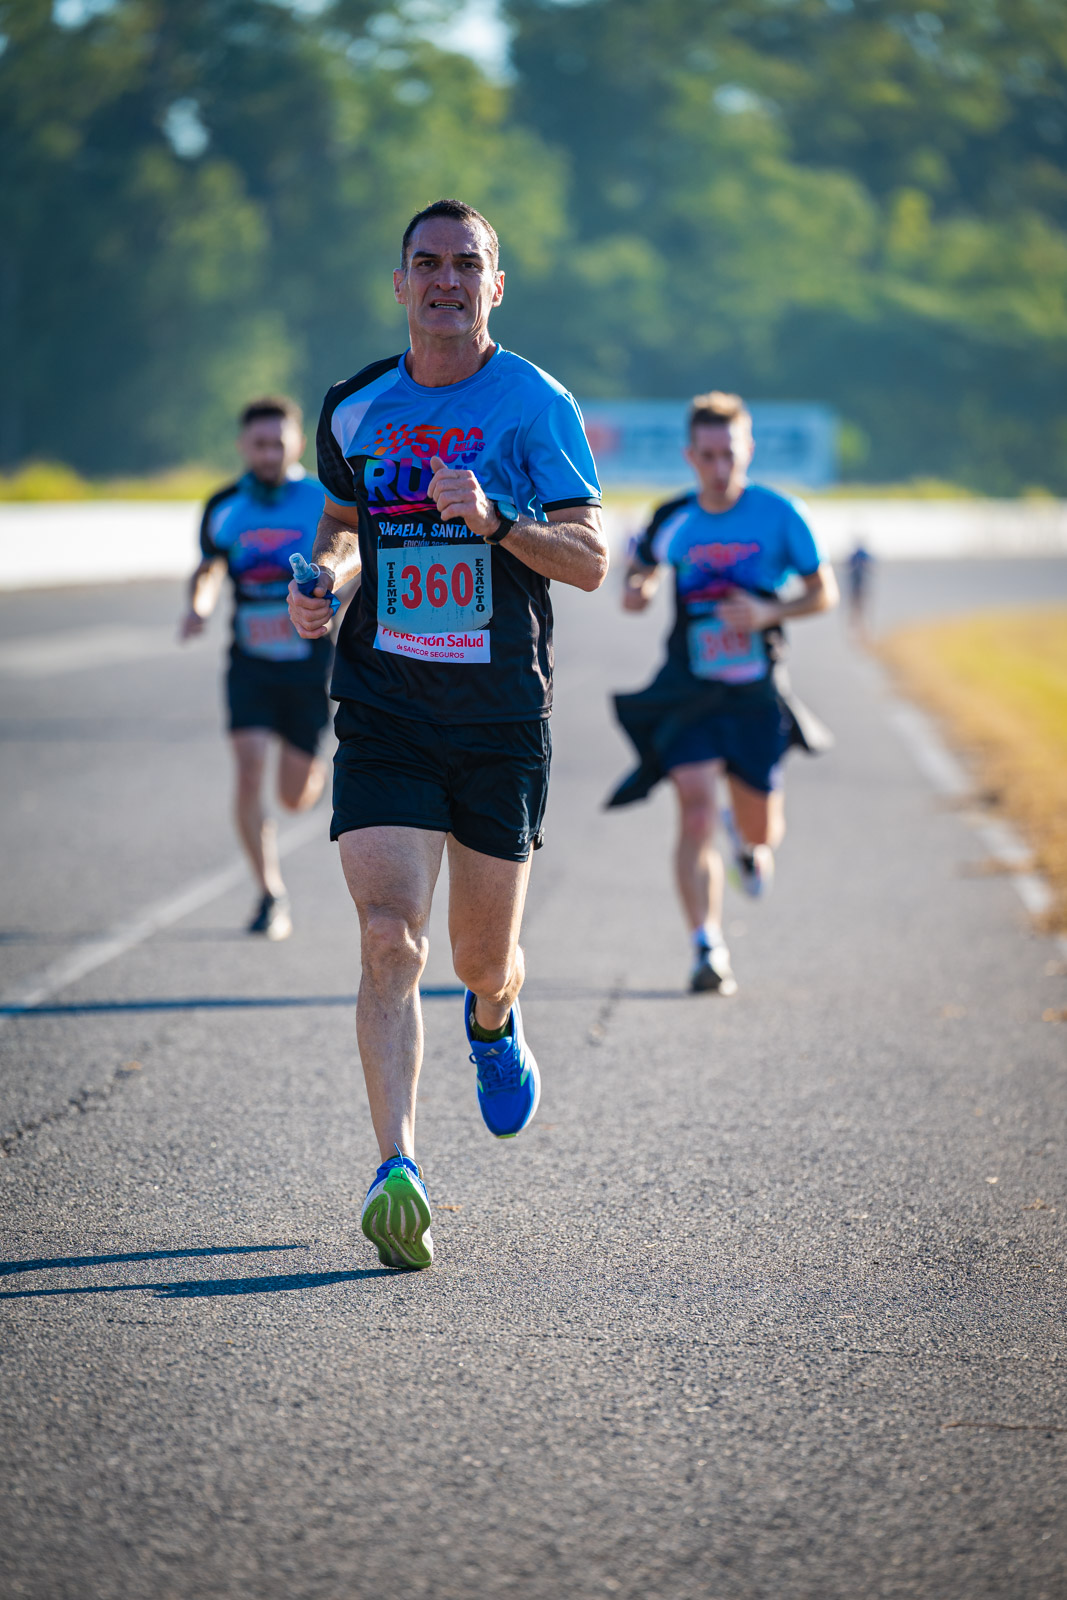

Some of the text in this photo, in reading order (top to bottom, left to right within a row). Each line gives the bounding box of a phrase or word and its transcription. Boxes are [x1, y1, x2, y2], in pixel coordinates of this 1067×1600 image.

[453, 441, 486, 452] MILLAS
[363, 457, 470, 502] RU
[378, 521, 427, 539] RAFAELA,
[430, 523, 468, 539] SANTA
[386, 561, 398, 615] TIEMPO
[400, 562, 474, 610] 360
[475, 558, 486, 613] EXACTO
[403, 645, 429, 657] SANCOR
[430, 651, 465, 659] SEGUROS
[446, 633, 484, 648] Salud
